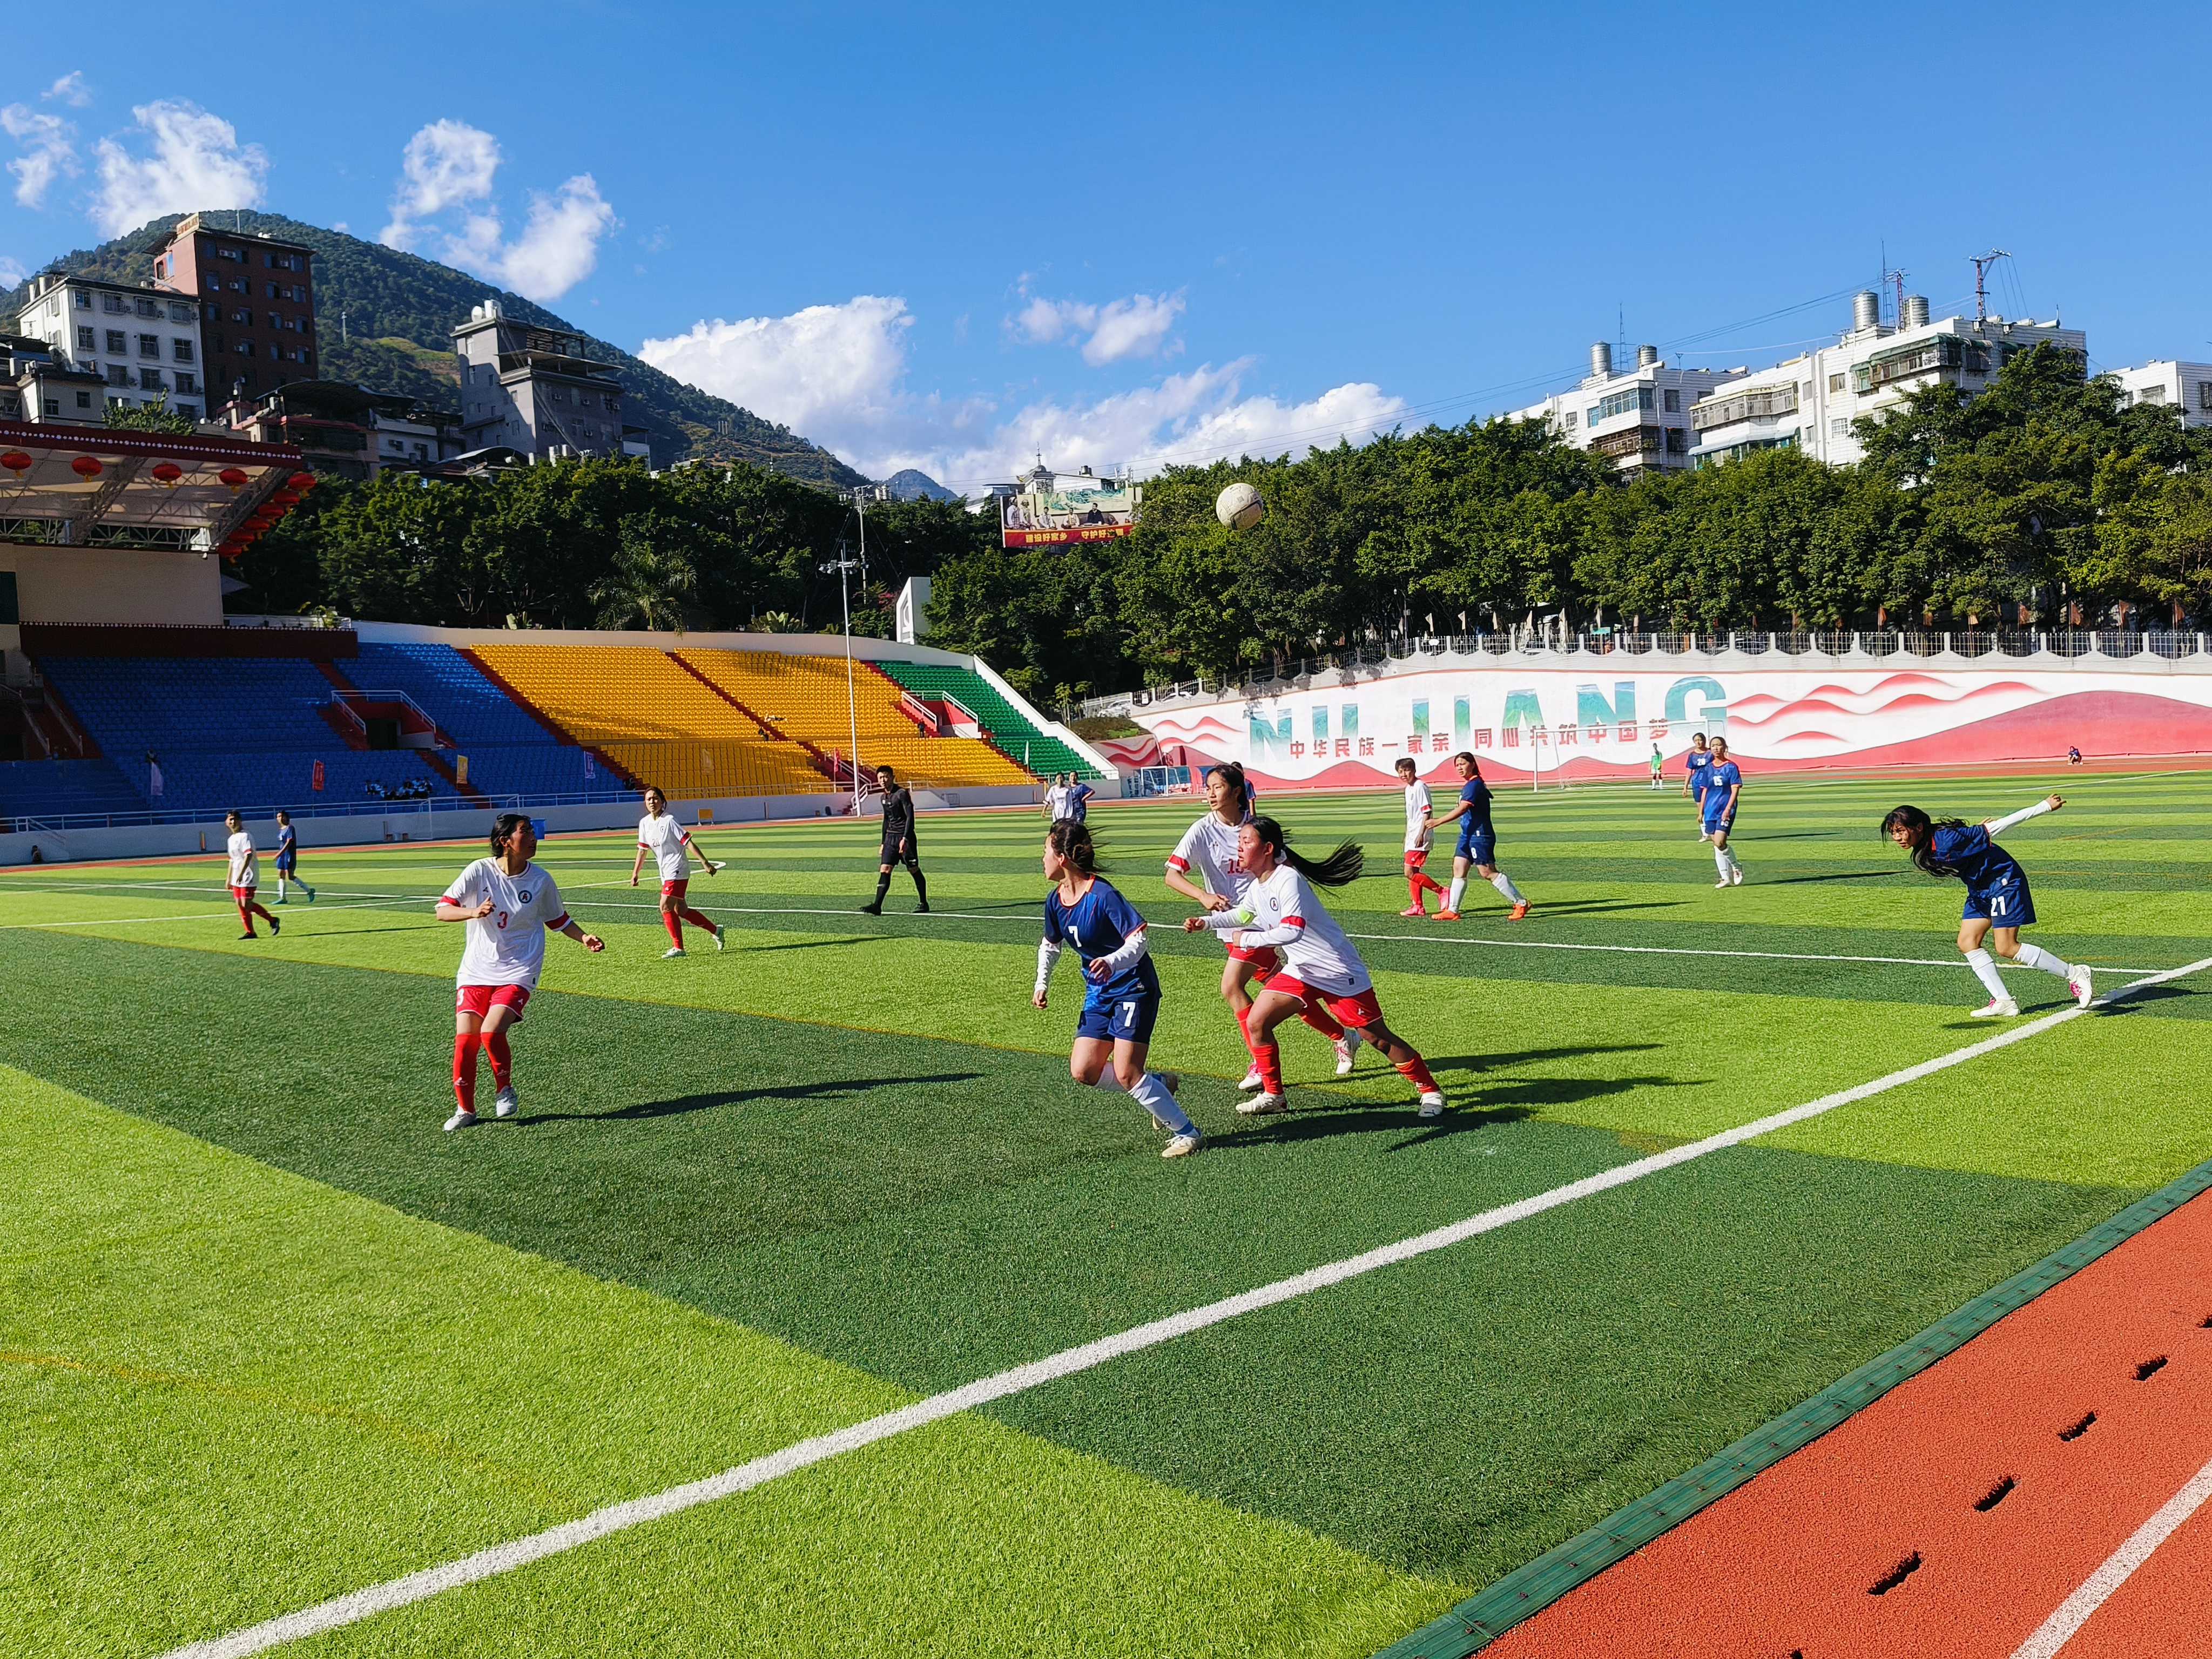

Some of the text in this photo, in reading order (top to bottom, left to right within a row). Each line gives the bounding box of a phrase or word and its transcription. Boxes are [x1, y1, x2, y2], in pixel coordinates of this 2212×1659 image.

[1290, 718, 1668, 759] 中华民族一家亲 同心共筑中国梦
[1471, 847, 1477, 859] 8
[1991, 895, 2006, 917] 21
[497, 911, 509, 929] 3
[1068, 925, 1082, 948] 7
[1123, 1002, 1136, 1027] 7
